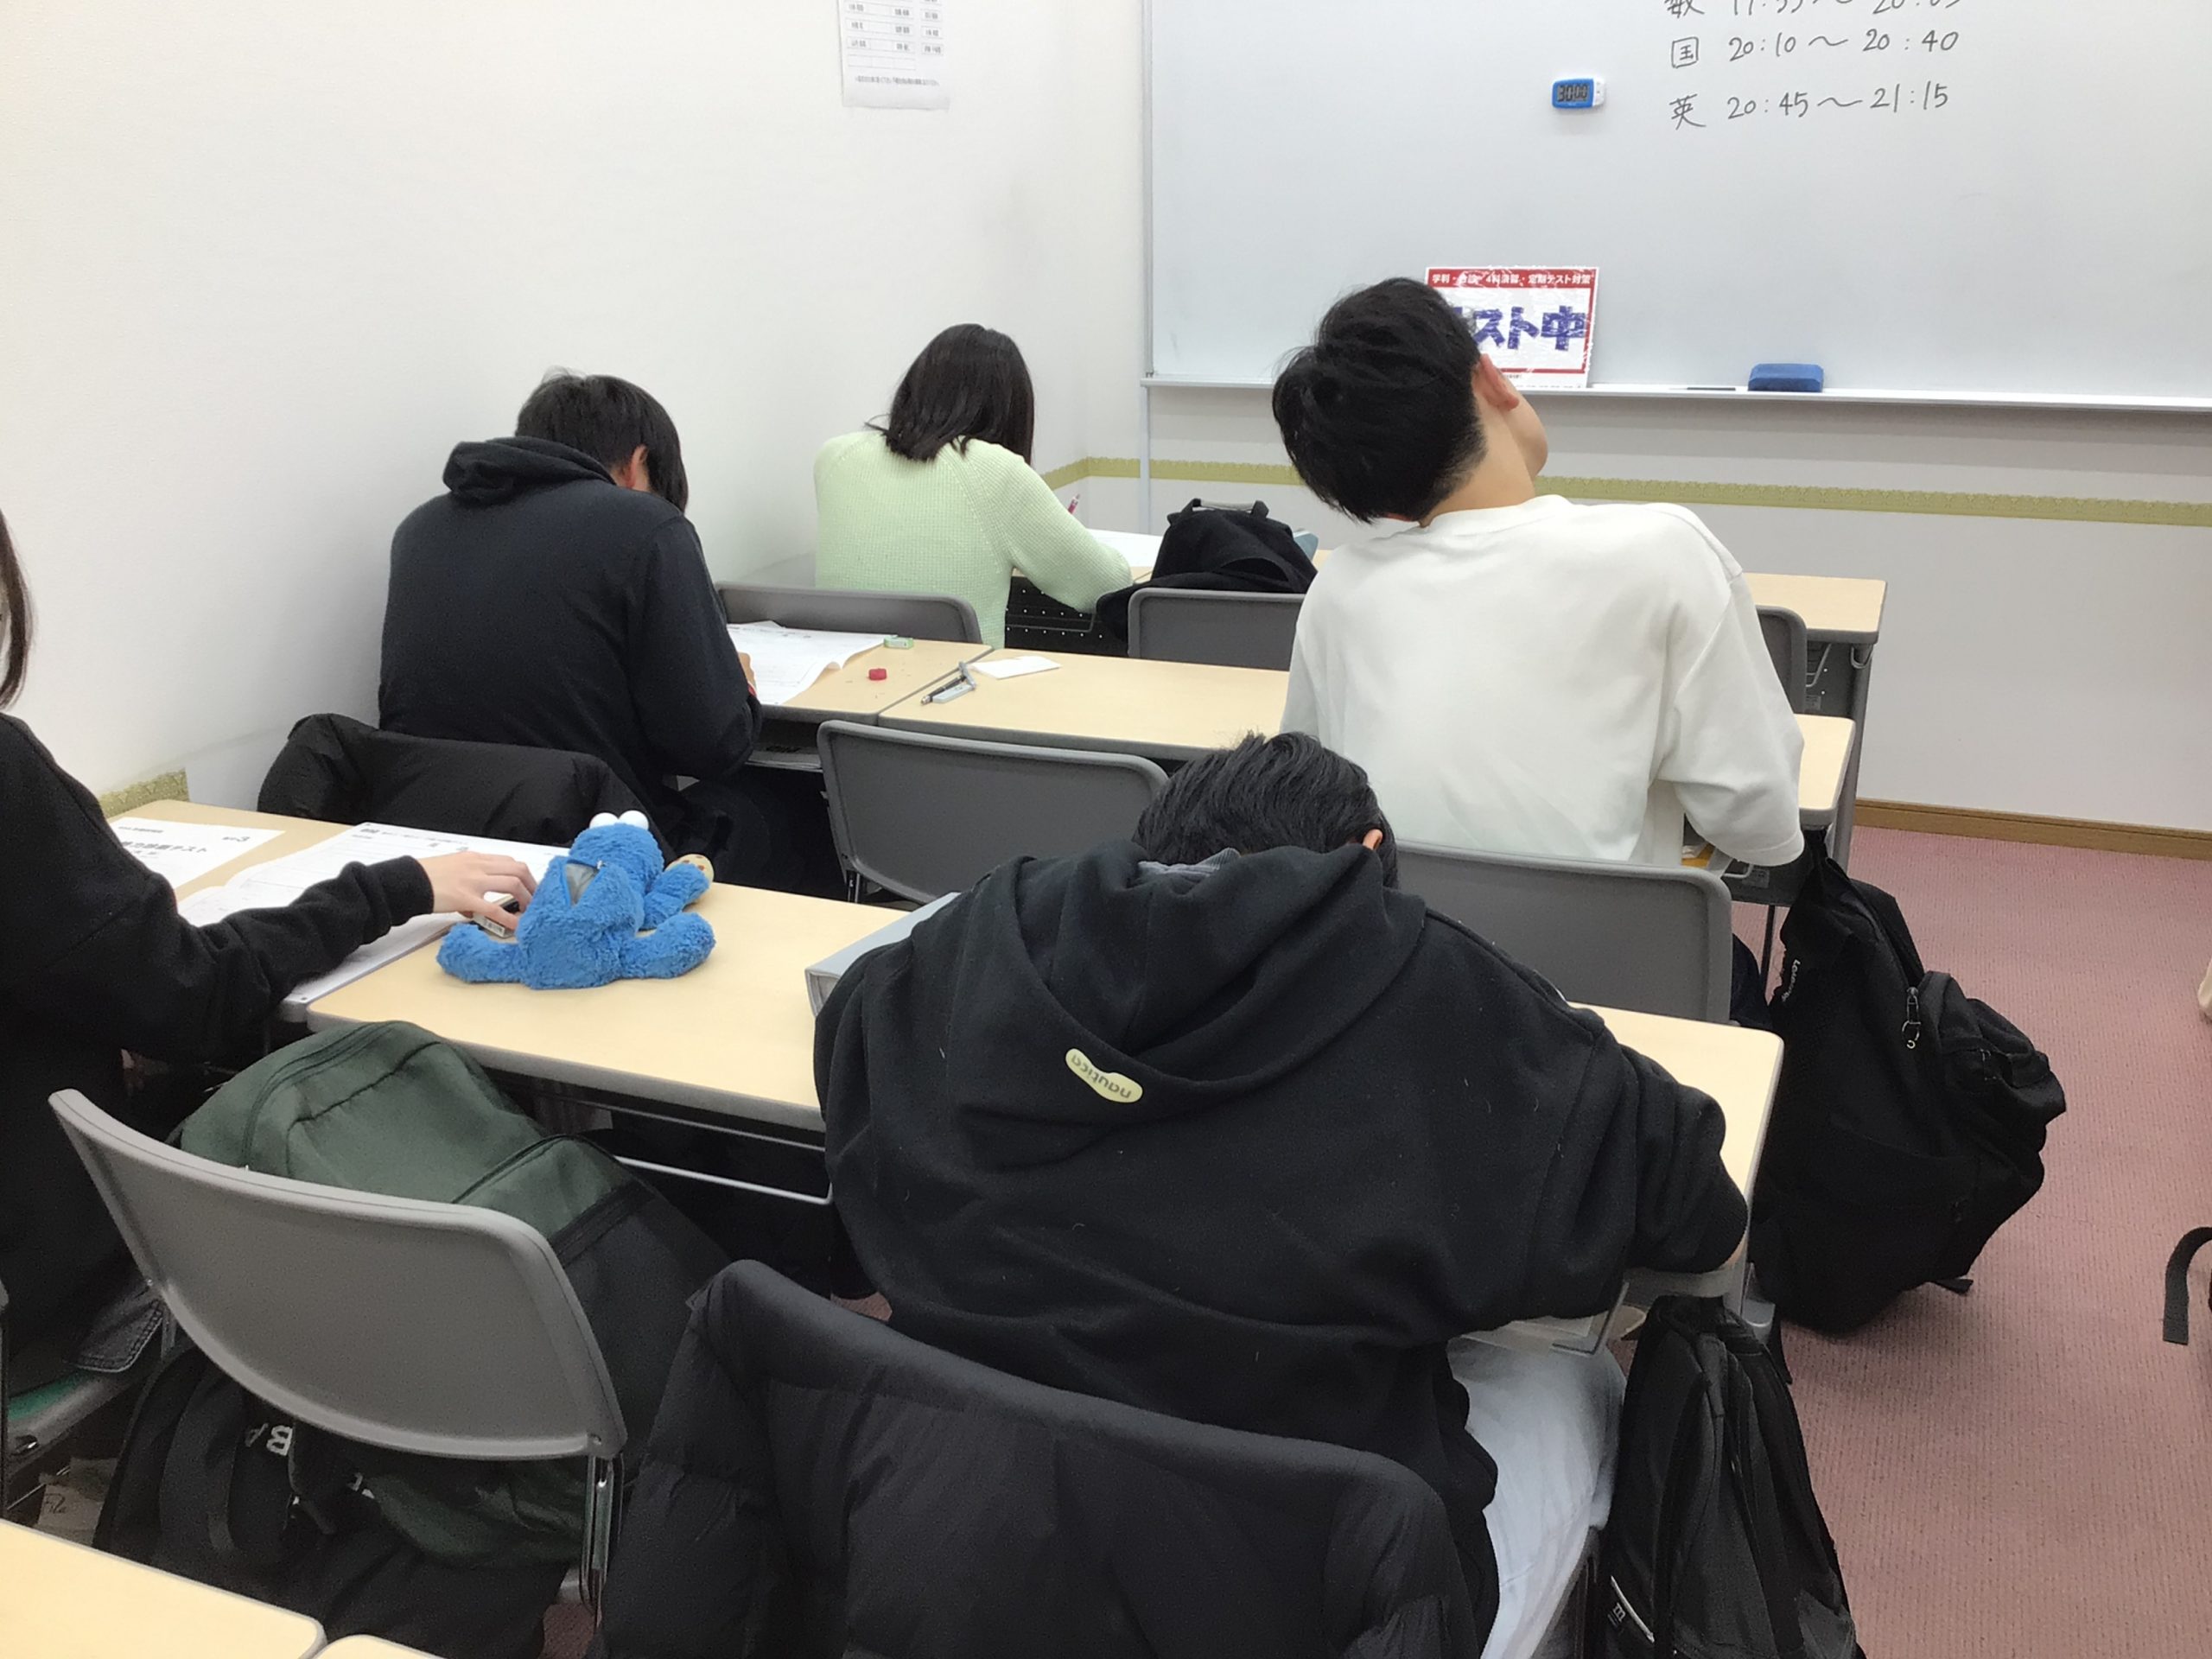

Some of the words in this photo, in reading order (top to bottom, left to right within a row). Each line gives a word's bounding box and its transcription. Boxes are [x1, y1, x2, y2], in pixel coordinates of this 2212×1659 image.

[1671, 36, 1700, 69] 国
[1669, 92, 1707, 130] 英
[1453, 305, 1587, 352] スト中
[1071, 1054, 1132, 1099] nautica
